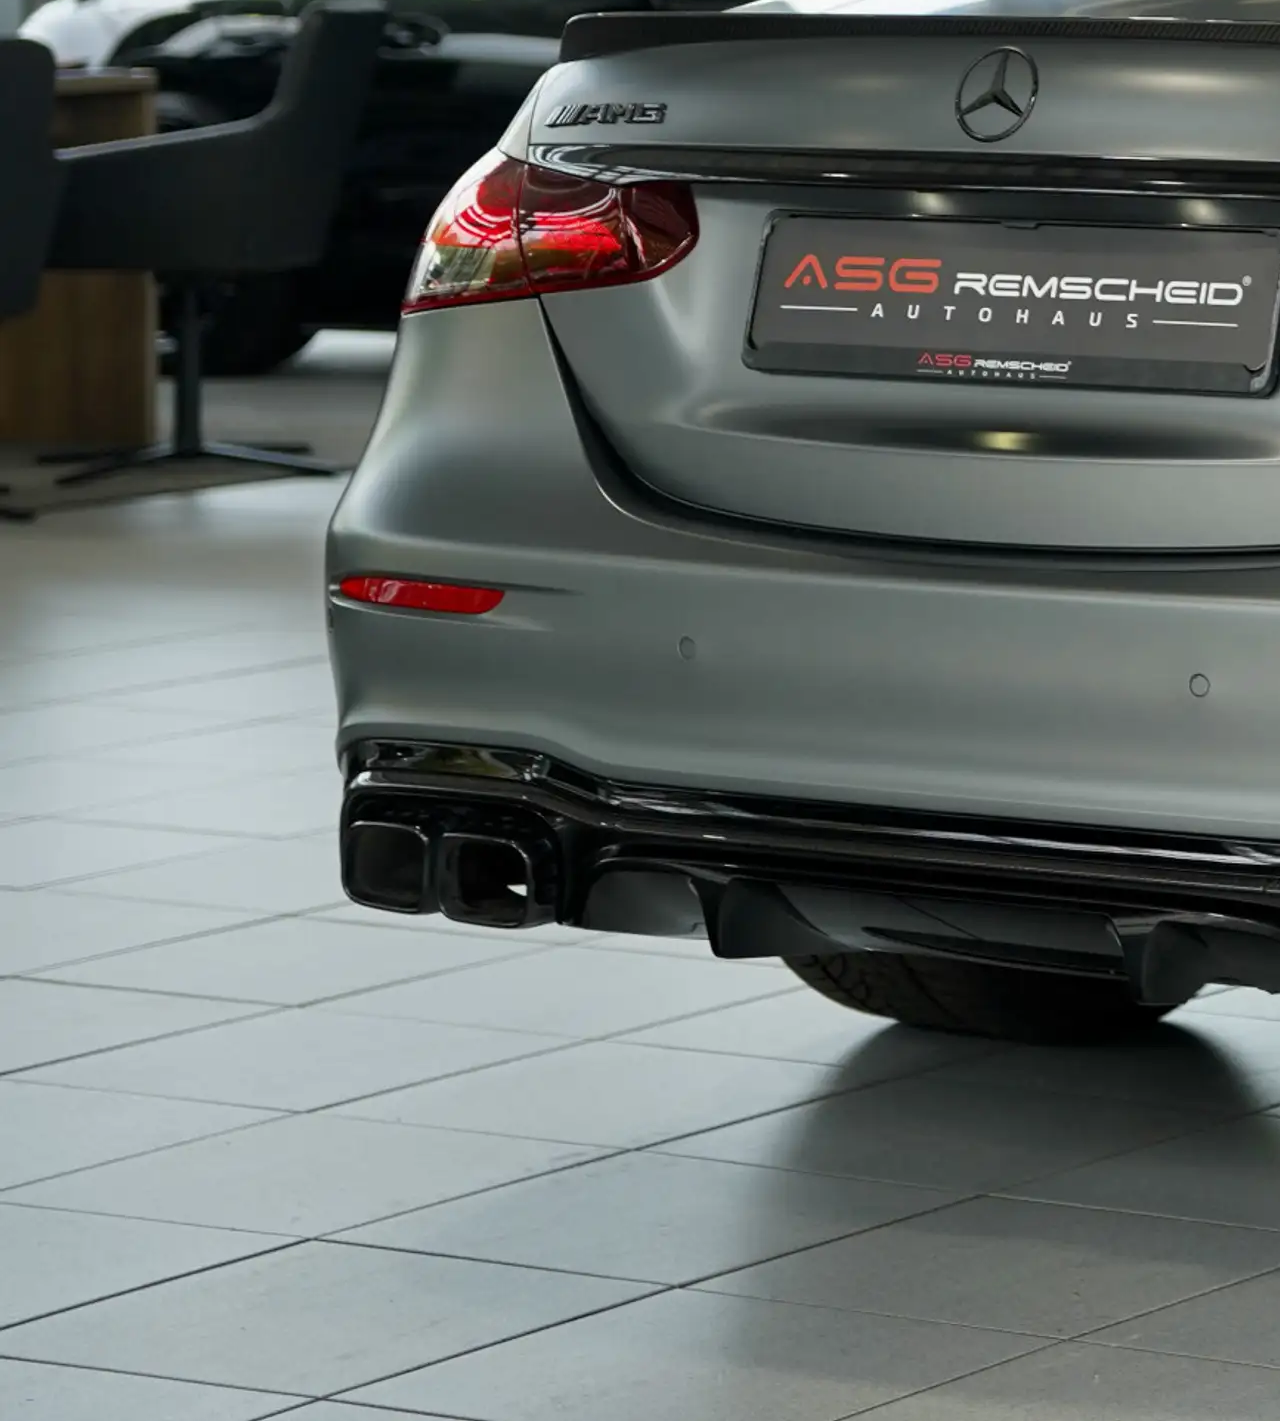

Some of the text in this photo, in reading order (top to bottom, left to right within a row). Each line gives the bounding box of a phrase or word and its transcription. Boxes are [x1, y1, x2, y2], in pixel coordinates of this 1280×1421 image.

[575, 102, 668, 125] AMG
[784, 253, 942, 294] ASG
[870, 302, 1139, 329] AUTOHAUS
[918, 352, 972, 367] ASG
